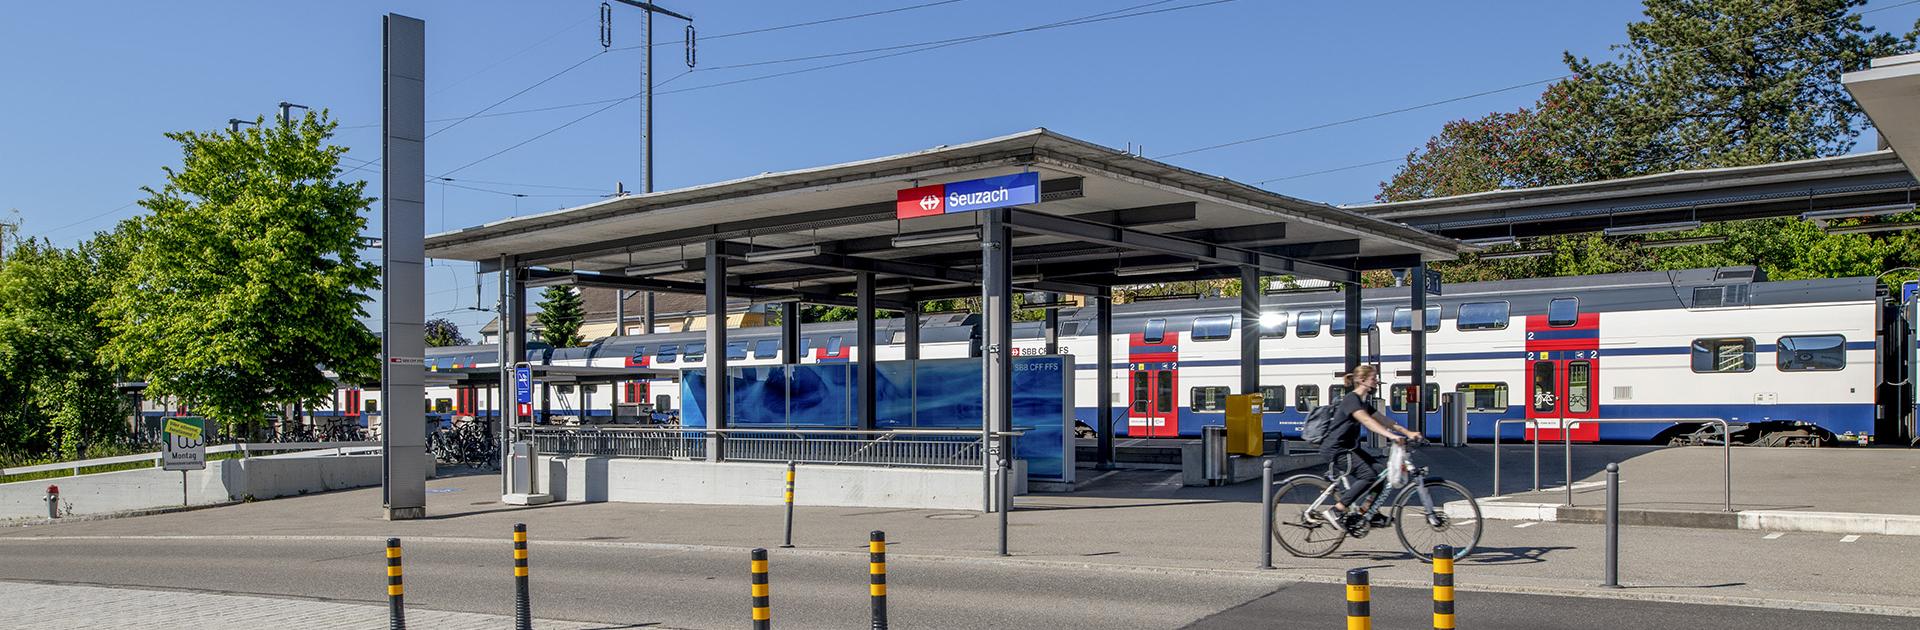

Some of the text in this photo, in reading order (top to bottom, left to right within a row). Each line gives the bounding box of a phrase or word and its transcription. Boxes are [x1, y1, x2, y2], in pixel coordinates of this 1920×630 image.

[949, 186, 1008, 207] Seuzach
[1435, 279, 1438, 291] 1
[1528, 332, 1534, 340] 2
[1022, 346, 1069, 355] SBB CF FS
[1590, 350, 1597, 359] 2
[1528, 352, 1534, 360] 2
[1014, 362, 1059, 372] SBB CFF FFS
[1129, 363, 1135, 371] 2
[1171, 362, 1177, 370] 2
[172, 452, 197, 460] Montag
